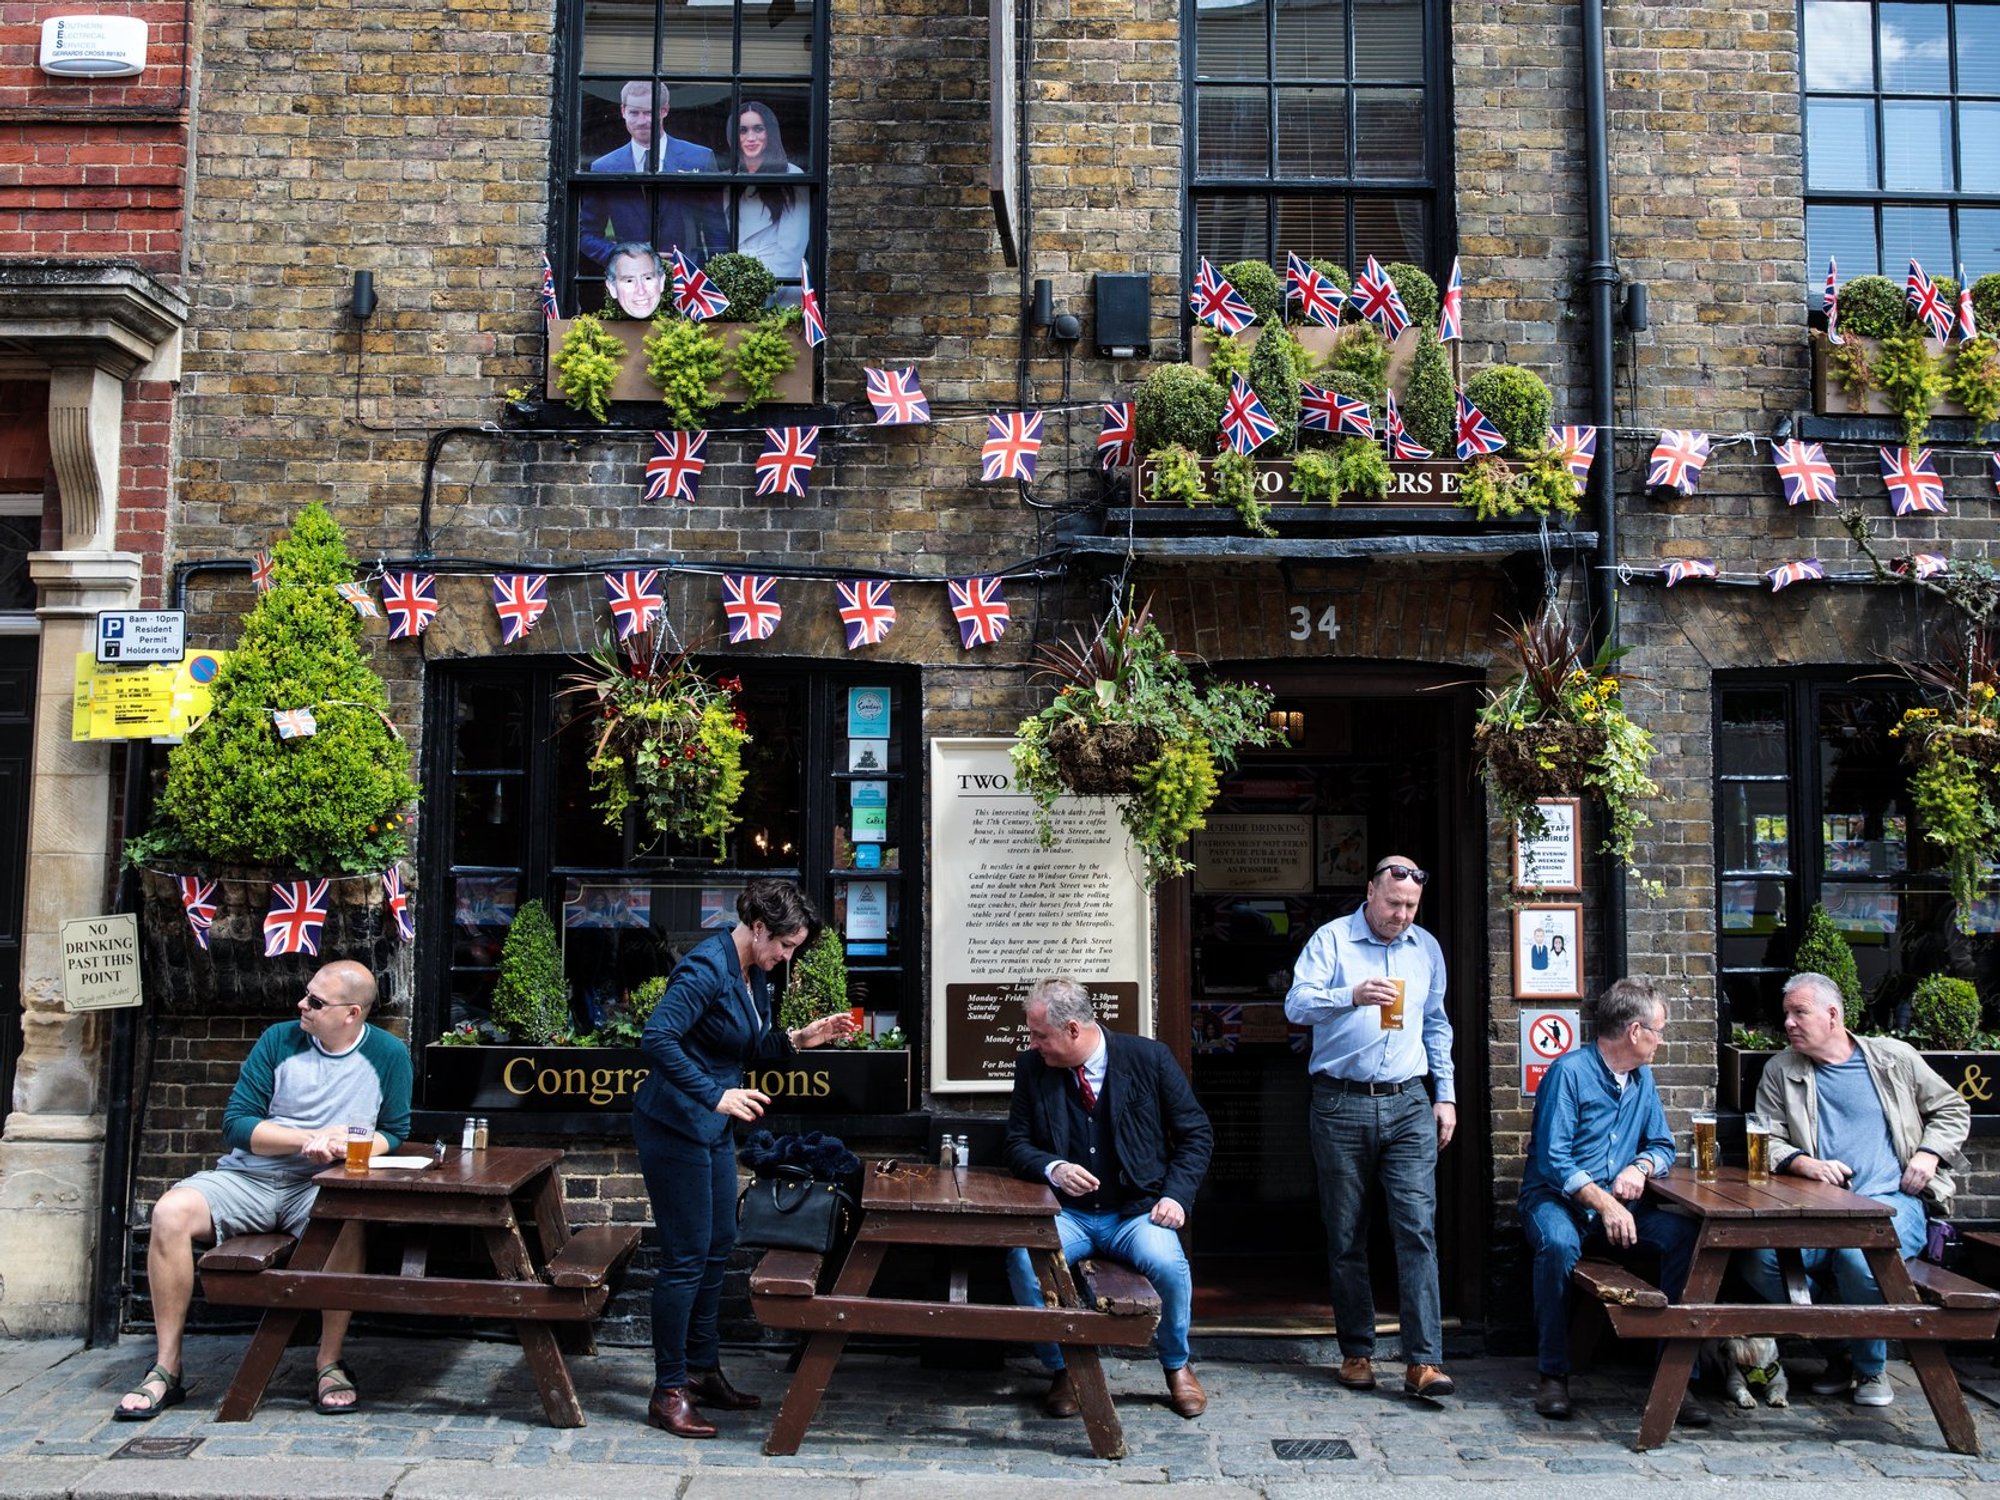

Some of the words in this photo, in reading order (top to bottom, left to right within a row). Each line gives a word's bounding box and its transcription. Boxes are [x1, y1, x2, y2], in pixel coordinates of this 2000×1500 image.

[129, 615, 147, 623] 8am
[156, 615, 179, 624] 10pm
[1290, 605, 1341, 640] 34
[107, 619, 122, 637] P
[110, 647, 115, 656] J
[126, 646, 159, 654] Holders
[161, 646, 180, 655] only
[957, 774, 1008, 790] TWO
[1251, 824, 1305, 832] DRINKING
[969, 873, 1007, 881] Cambridge
[1087, 892, 1110, 900] rolling
[1063, 901, 1082, 909] fresh
[1083, 901, 1101, 909] from
[995, 911, 1011, 919] yard
[1067, 911, 1092, 919] settling
[88, 923, 108, 937] NO
[65, 937, 133, 954] DRINKING
[990, 938, 1006, 946] days
[1001, 947, 1029, 955] peaceful
[68, 957, 99, 970] PAST
[102, 953, 134, 968] THIS
[1032, 957, 1052, 965] ready
[989, 966, 1005, 974] good
[1008, 966, 1034, 974] English
[1056, 966, 1071, 974] fine
[81, 970, 122, 985] POINT
[967, 994, 998, 1003] Monday
[1092, 993, 1119, 1002] 2.30pm
[967, 1003, 1001, 1012] Saturday
[967, 1012, 996, 1021] Sunday
[985, 1035, 1015, 1044] Monday
[982, 1060, 996, 1068] For
[1957, 1064, 1993, 1101] &
